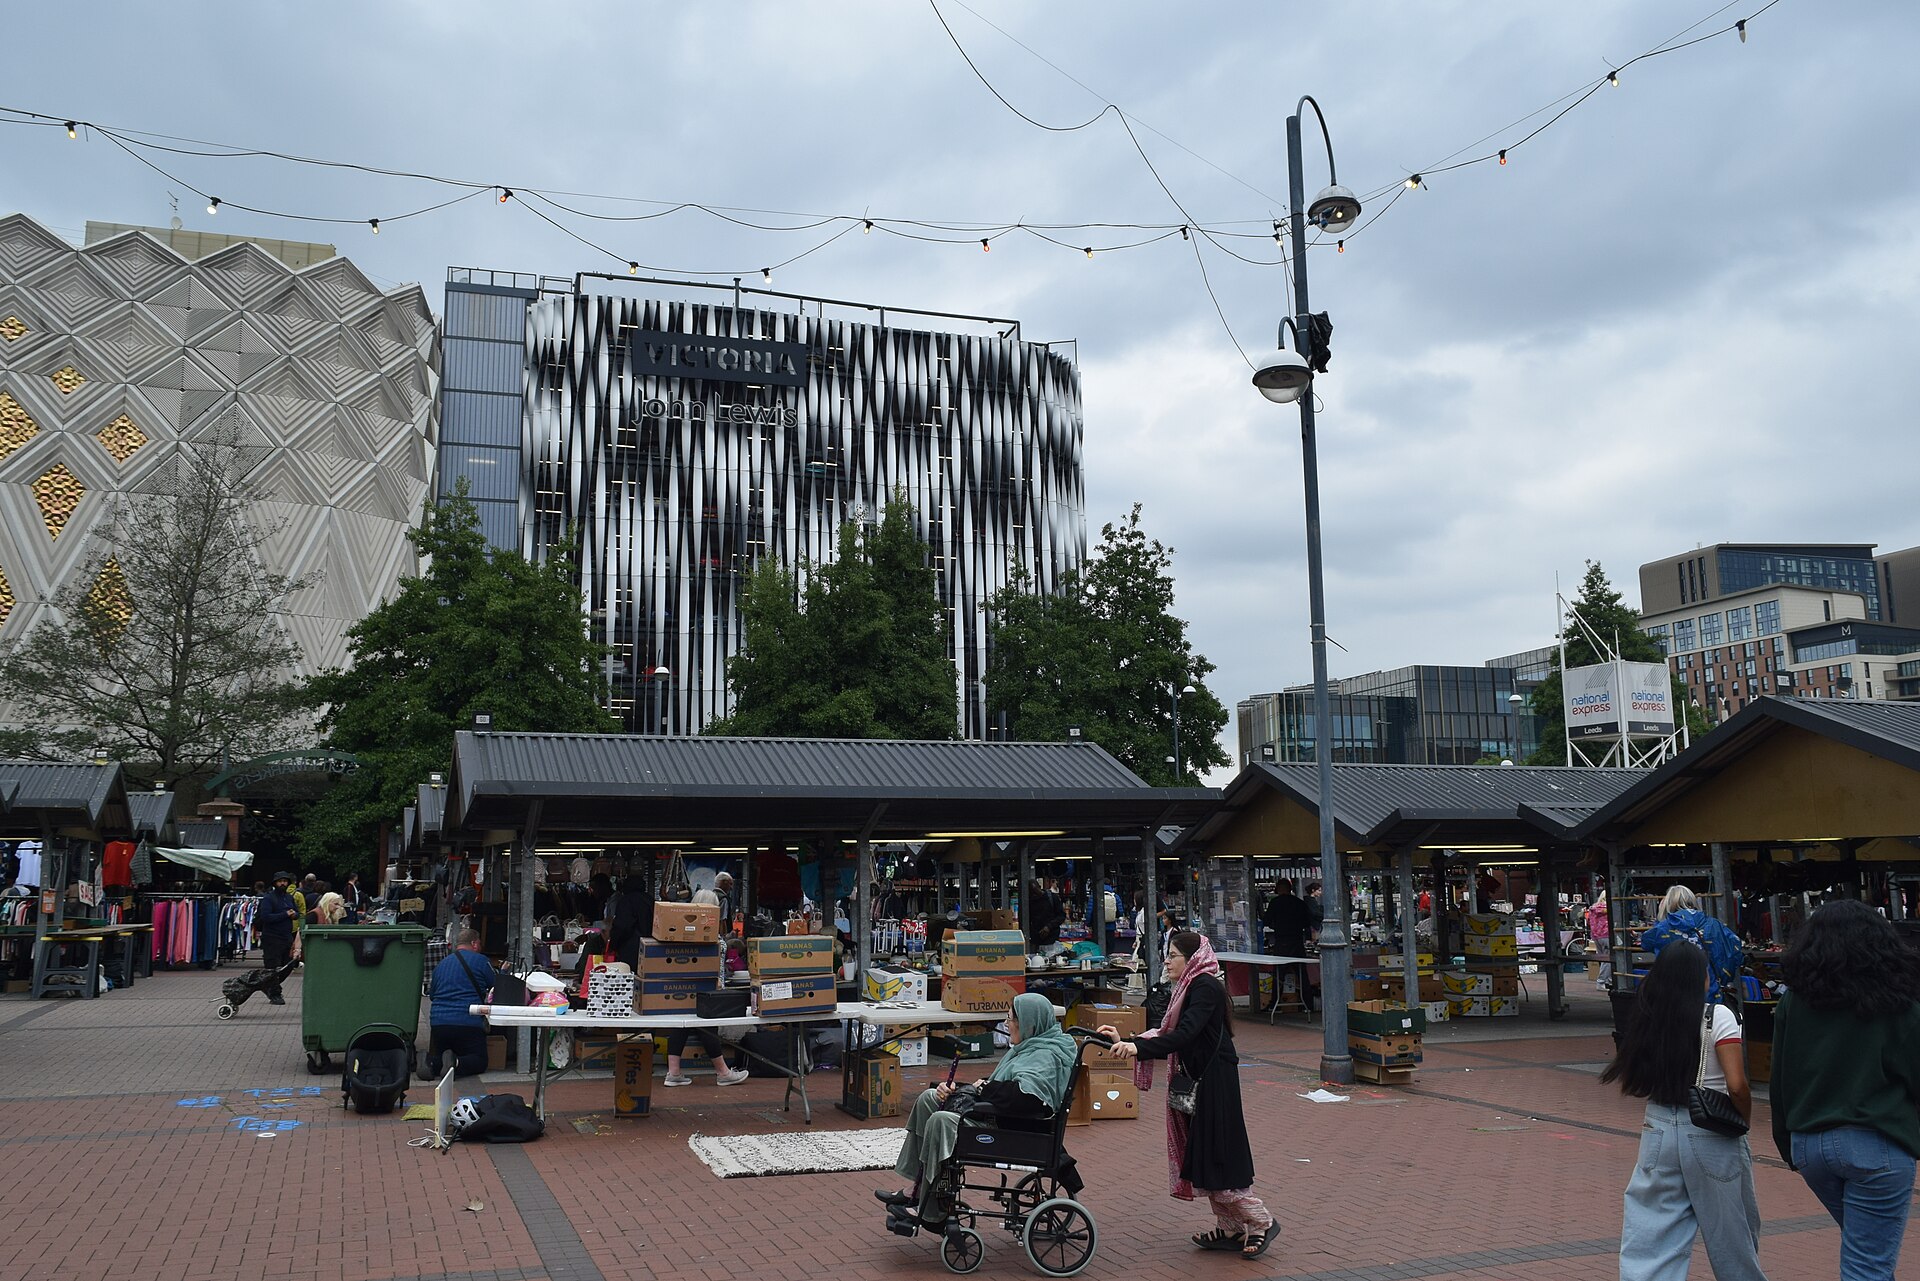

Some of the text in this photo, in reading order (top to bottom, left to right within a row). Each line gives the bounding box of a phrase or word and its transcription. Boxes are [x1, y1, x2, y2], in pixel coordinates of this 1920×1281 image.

[644, 342, 798, 376] VICTORIA
[631, 386, 798, 428] John Lewis
[1571, 690, 1610, 706] national
[1631, 690, 1665, 702] national
[1572, 702, 1611, 717] express
[1631, 701, 1666, 713] express
[1584, 726, 1603, 735] Leeds
[1643, 724, 1660, 732] Leeds
[779, 942, 813, 950] BANANAS
[967, 1001, 1010, 1011] TURBANA
